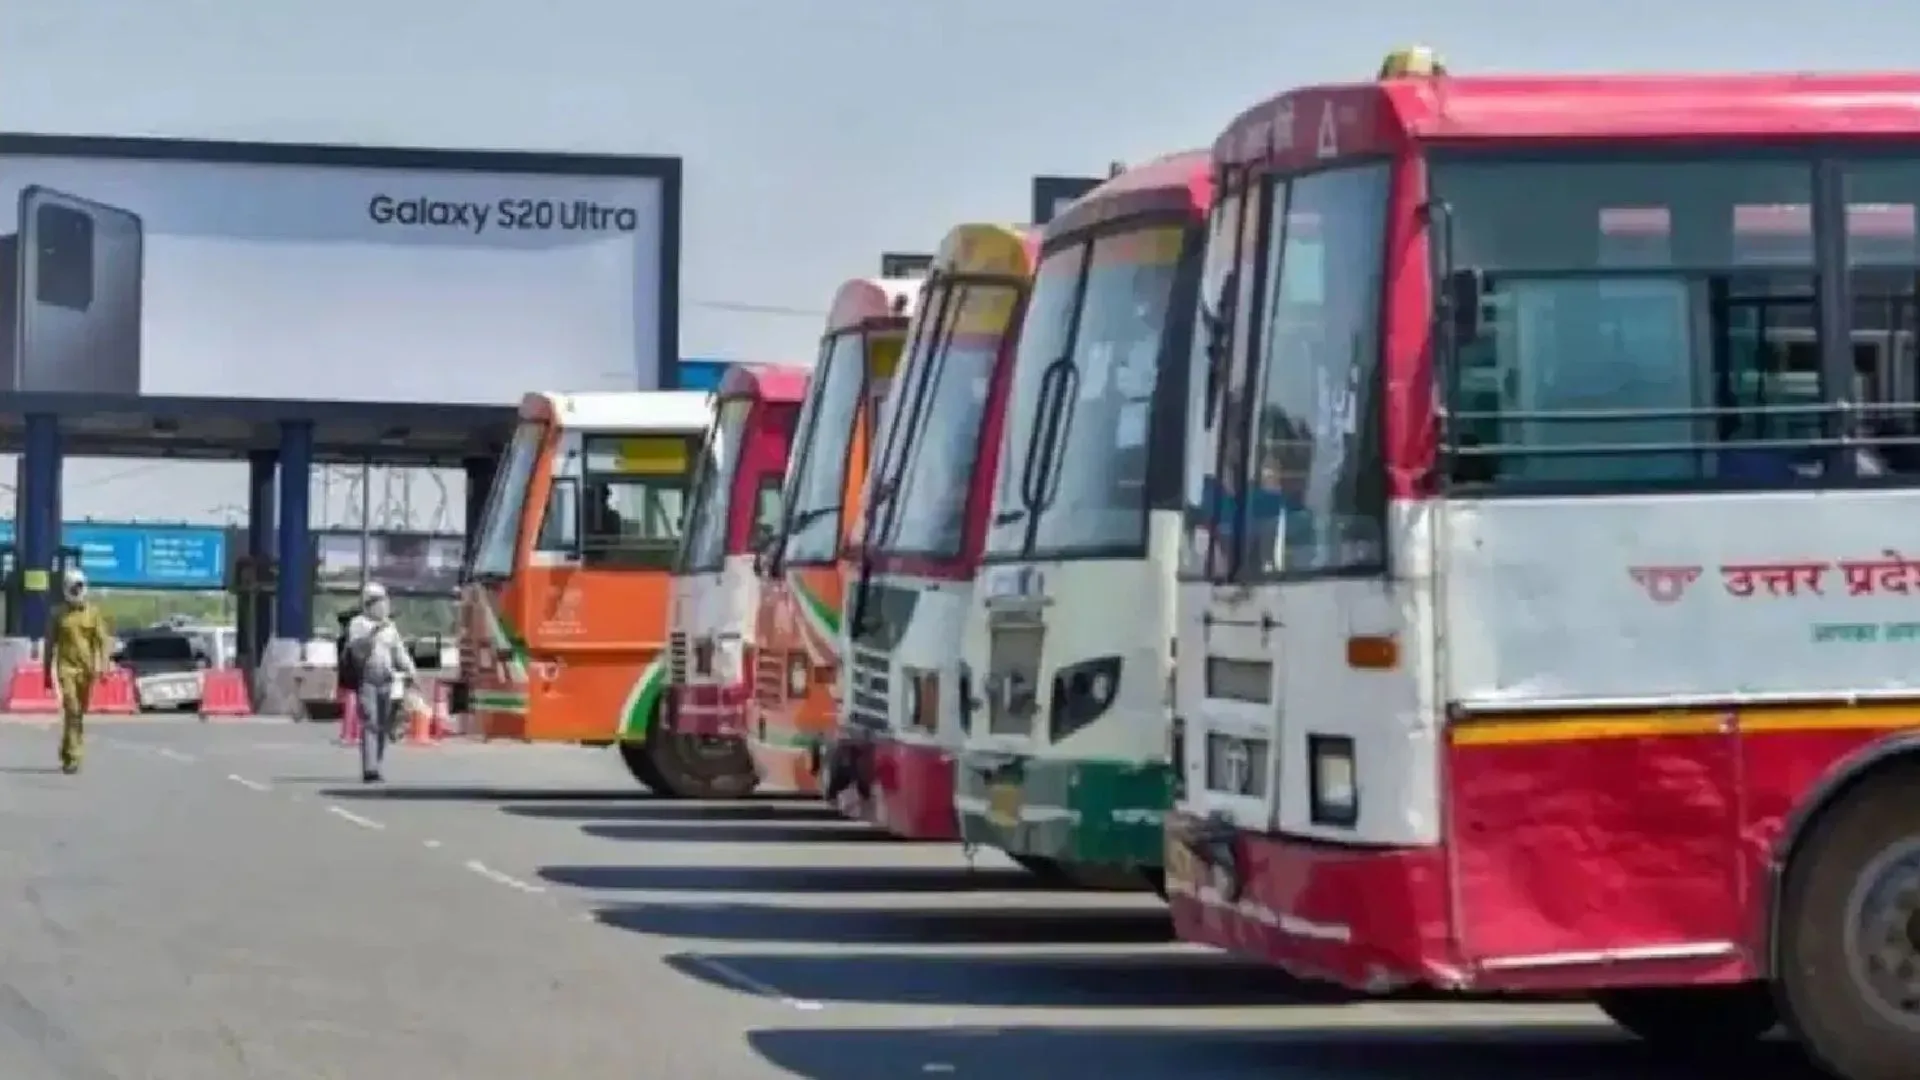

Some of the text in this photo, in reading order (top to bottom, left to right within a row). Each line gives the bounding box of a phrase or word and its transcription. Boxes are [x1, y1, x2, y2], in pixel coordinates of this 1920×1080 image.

[369, 194, 638, 233] Galaxy S20 Ultra
[1719, 548, 1920, 597] उत्तर प्रदे
